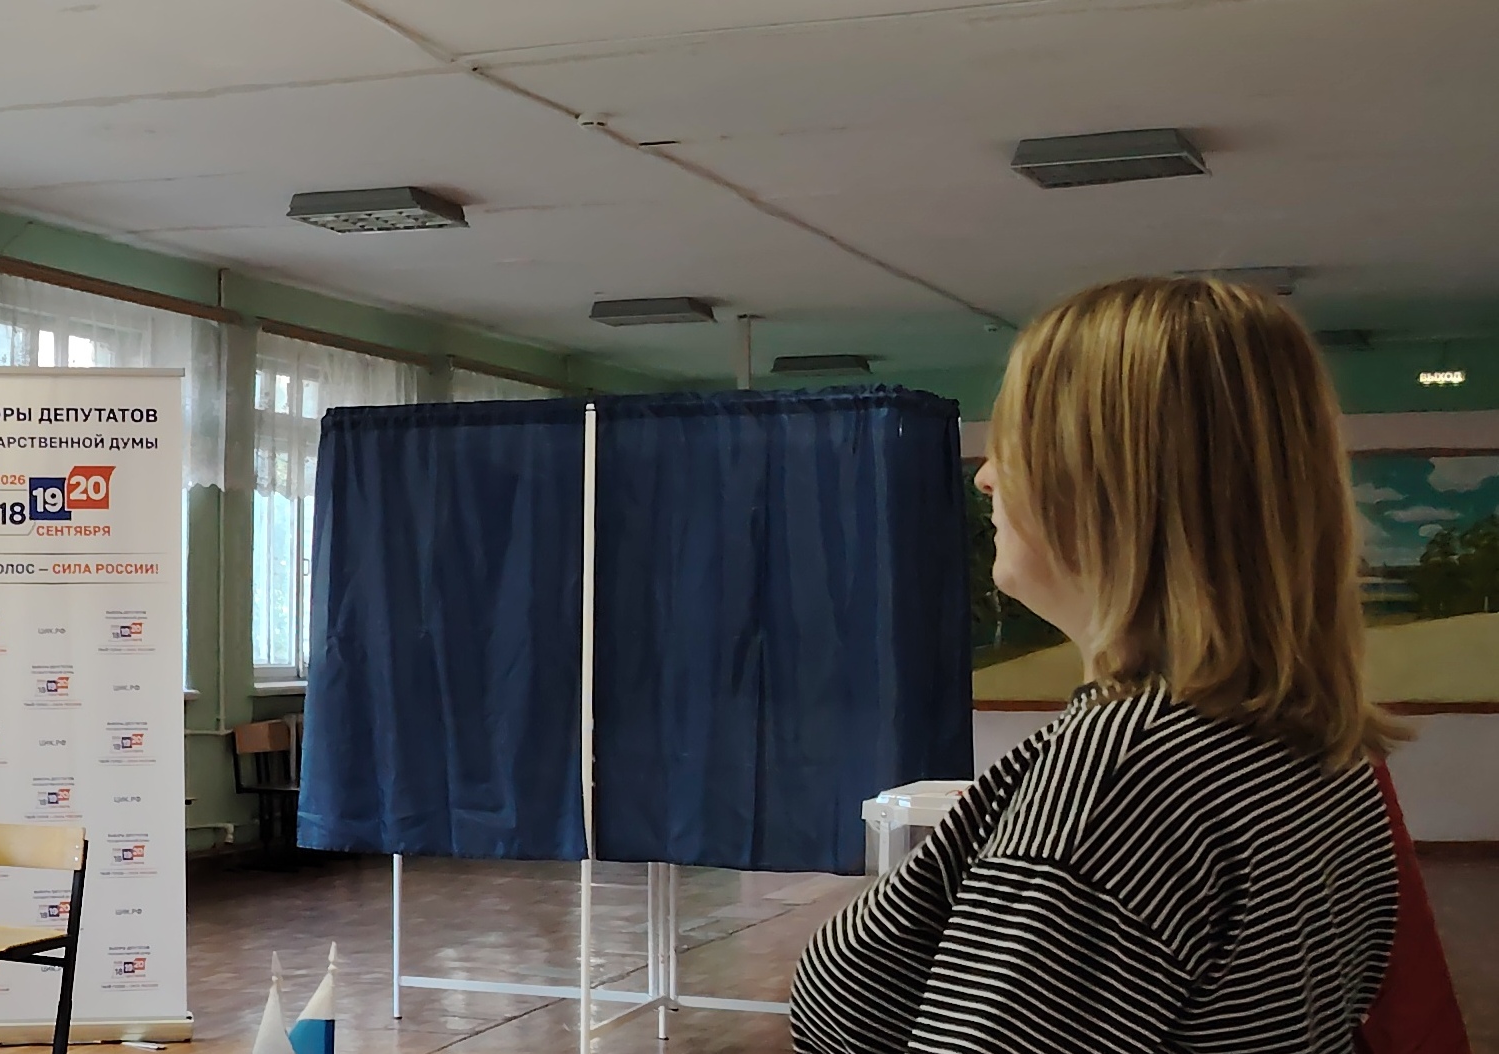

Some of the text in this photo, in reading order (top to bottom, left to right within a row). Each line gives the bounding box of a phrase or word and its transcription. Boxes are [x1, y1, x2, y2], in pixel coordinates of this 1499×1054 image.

[1419, 371, 1465, 385] ВЫХОД
[38, 407, 158, 424] ДЕПУТАТОВ
[109, 437, 158, 451] ДУМЫ
[32, 487, 63, 512] 19
[69, 475, 107, 501] 20
[36, 525, 111, 537] СЕНТЯБРЯ
[52, 563, 92, 575] СИЛА
[95, 563, 159, 575] РОССИИ!
